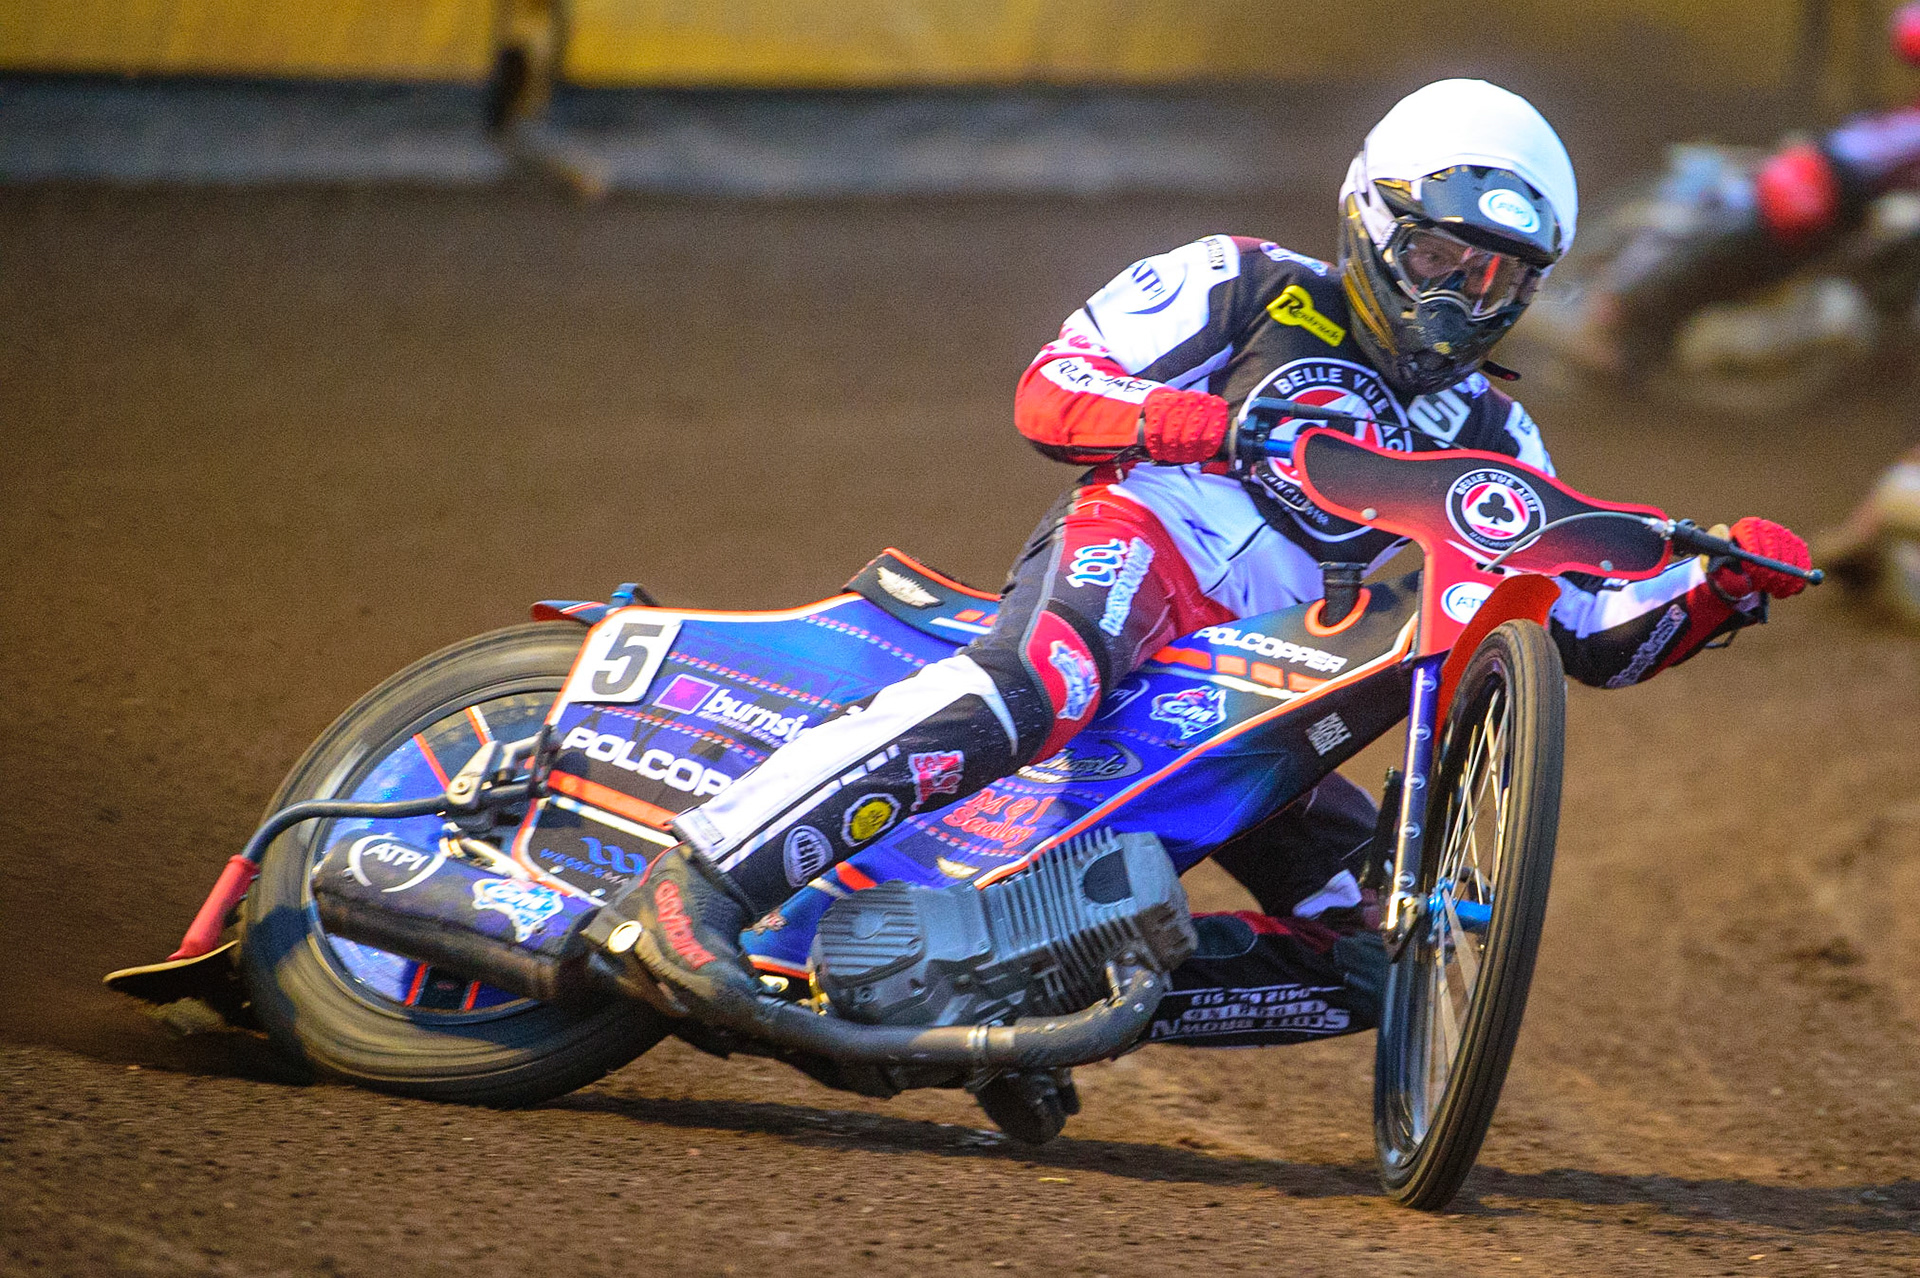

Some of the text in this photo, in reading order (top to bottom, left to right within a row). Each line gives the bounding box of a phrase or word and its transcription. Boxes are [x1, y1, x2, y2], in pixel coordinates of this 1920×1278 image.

[1273, 367, 1343, 395] BELLE
[1354, 374, 1390, 414] VUE
[1454, 473, 1487, 495] BELLE
[1489, 473, 1516, 487] VUE
[591, 623, 665, 695] 5
[1194, 626, 1347, 673] POLCOPPER
[702, 689, 810, 742] burnsi
[561, 727, 733, 796] POLCOP
[364, 842, 430, 872] ATPI
